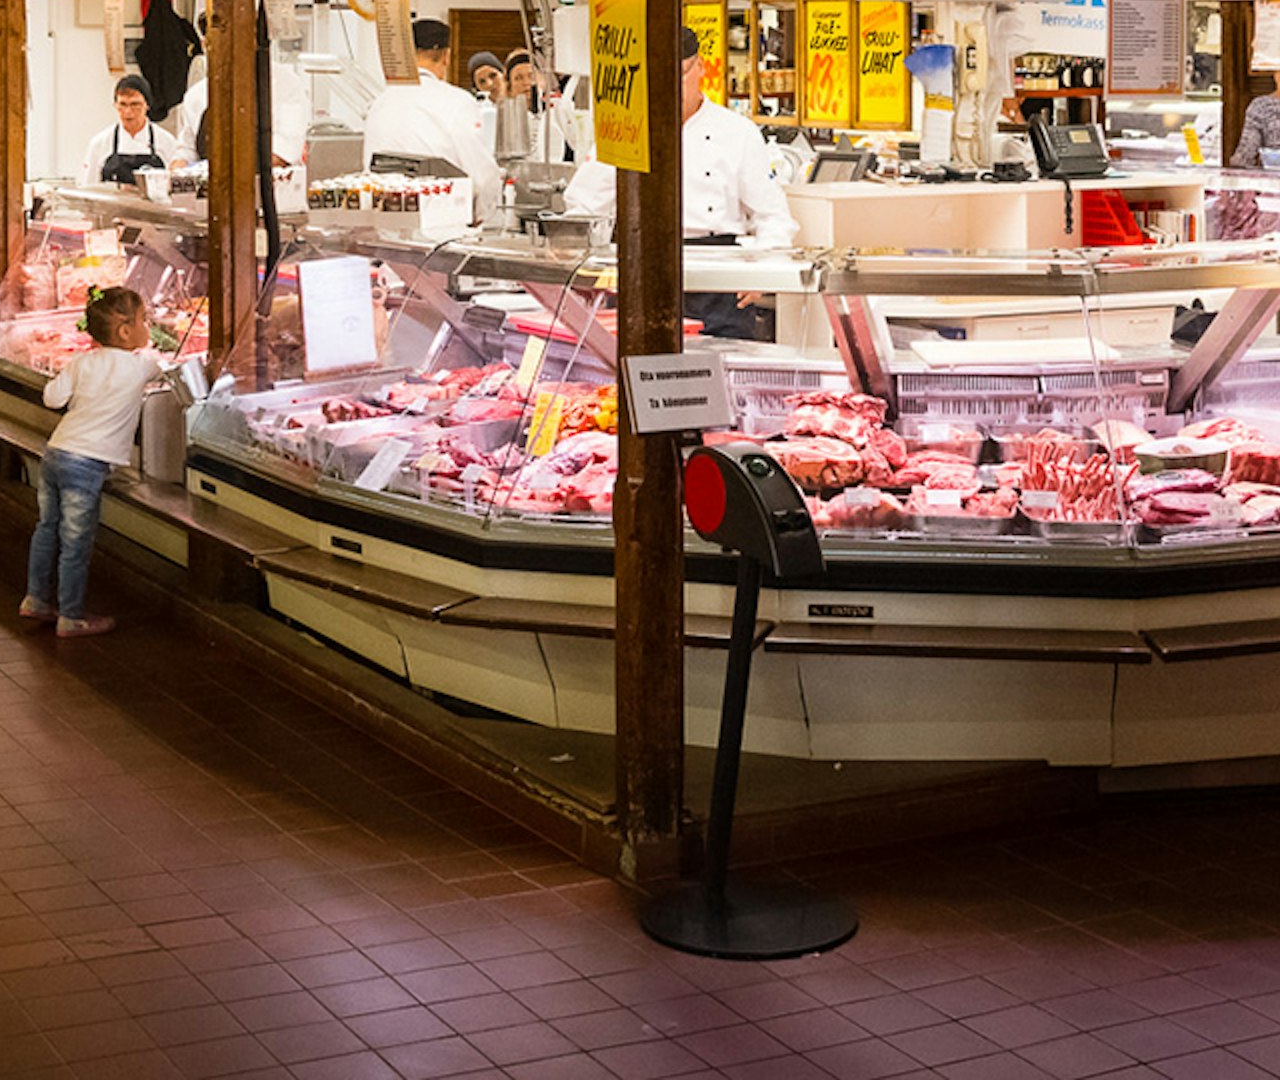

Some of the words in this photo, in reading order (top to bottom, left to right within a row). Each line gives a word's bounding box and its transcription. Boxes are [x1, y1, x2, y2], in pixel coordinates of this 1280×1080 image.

[1040, 10, 1105, 30] Termokass
[861, 49, 903, 76] LIHAT
[594, 62, 641, 110] LIHAT
